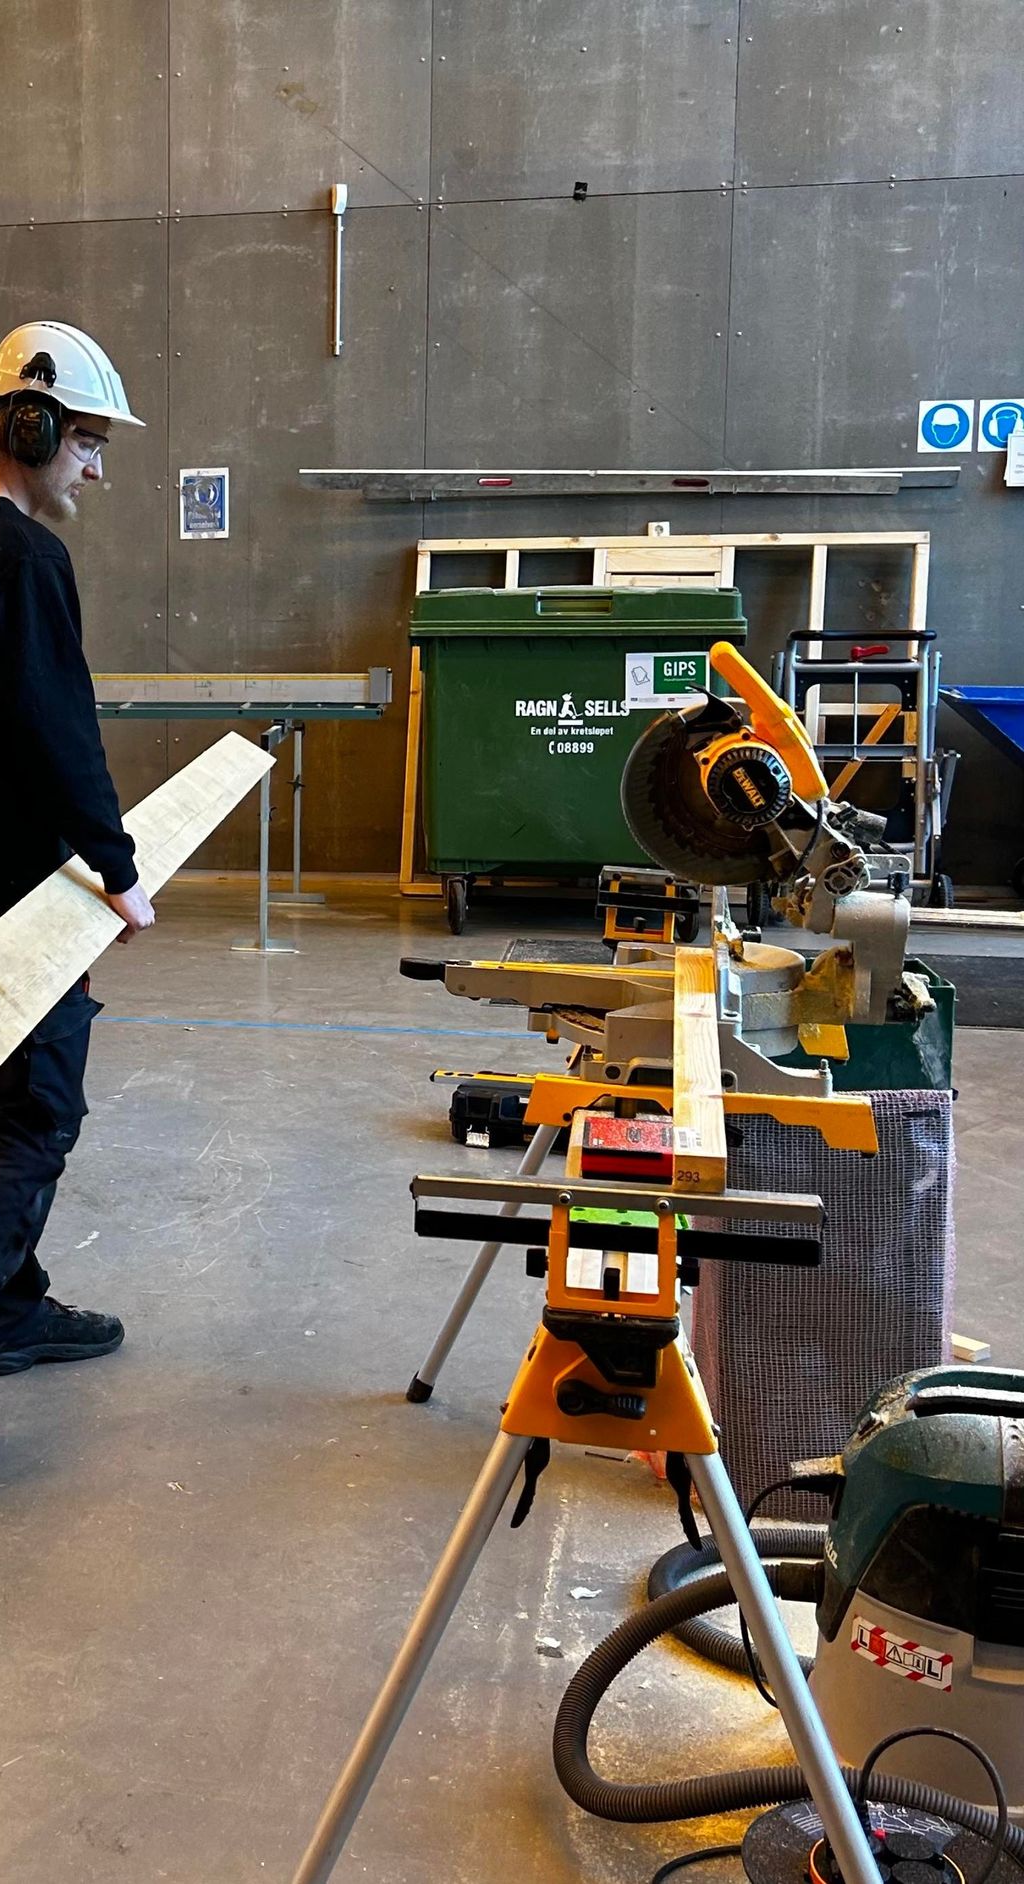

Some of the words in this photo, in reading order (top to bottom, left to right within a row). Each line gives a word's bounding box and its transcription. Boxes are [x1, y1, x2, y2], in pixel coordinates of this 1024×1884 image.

[663, 661, 696, 676] GIPS
[515, 700, 557, 716] RAGN
[584, 700, 630, 716] SELLS
[530, 726, 542, 736] En
[543, 726, 556, 736] del
[557, 728, 569, 736] av
[557, 741, 594, 754] 08899
[732, 766, 766, 809] DEWALT
[677, 1170, 700, 1184] 293
[926, 1657, 940, 1678] L
